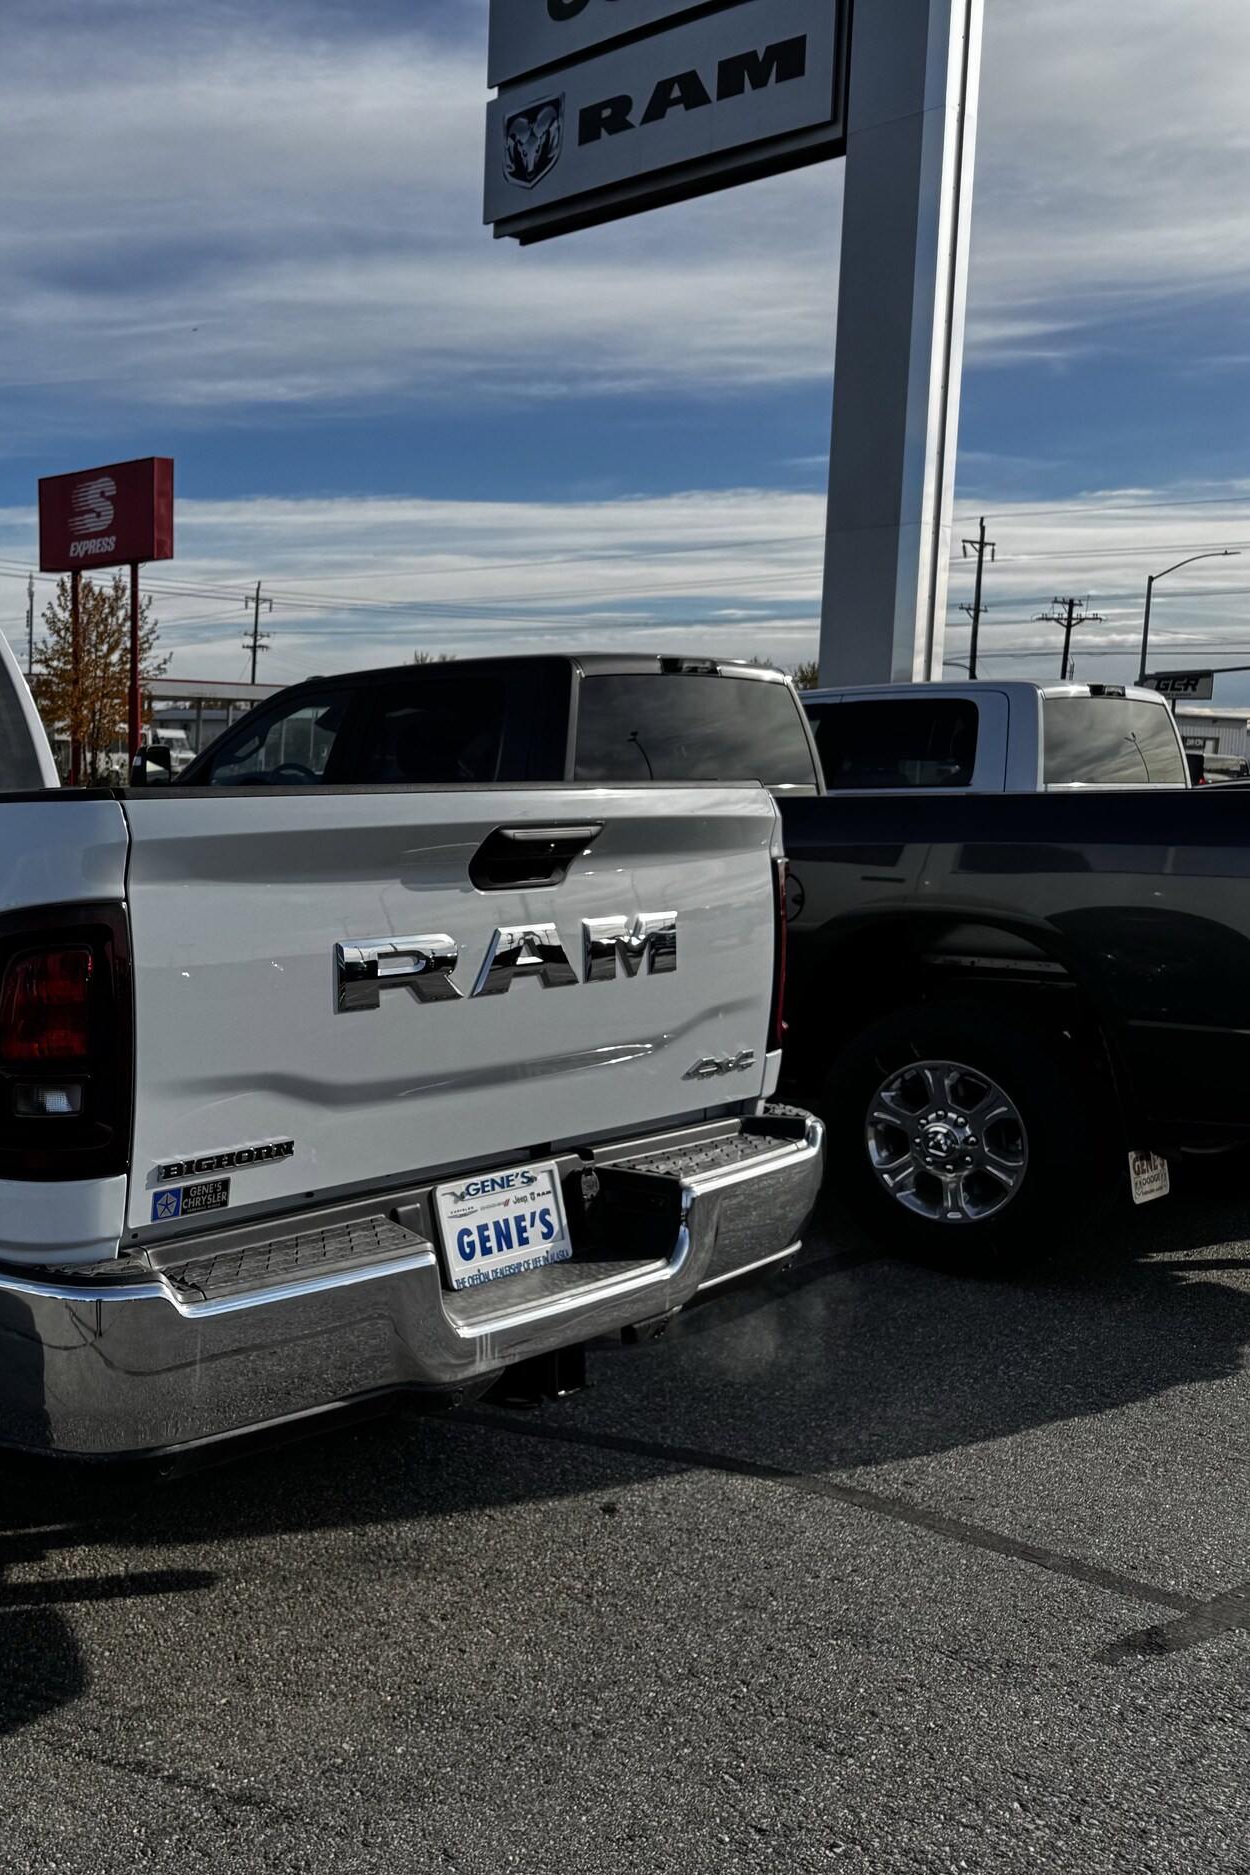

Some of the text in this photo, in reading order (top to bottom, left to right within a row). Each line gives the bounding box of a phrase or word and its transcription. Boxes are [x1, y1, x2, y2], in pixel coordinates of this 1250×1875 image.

[578, 34, 807, 147] RAM
[69, 536, 117, 558] EXPRESS
[332, 911, 678, 1016] RAM
[190, 1182, 222, 1197] GENE'S
[465, 1170, 531, 1197] GENE'S
[183, 1191, 228, 1209] CHRYSLER
[513, 1194, 528, 1205] Jeep
[457, 1208, 555, 1261] GENE'S
